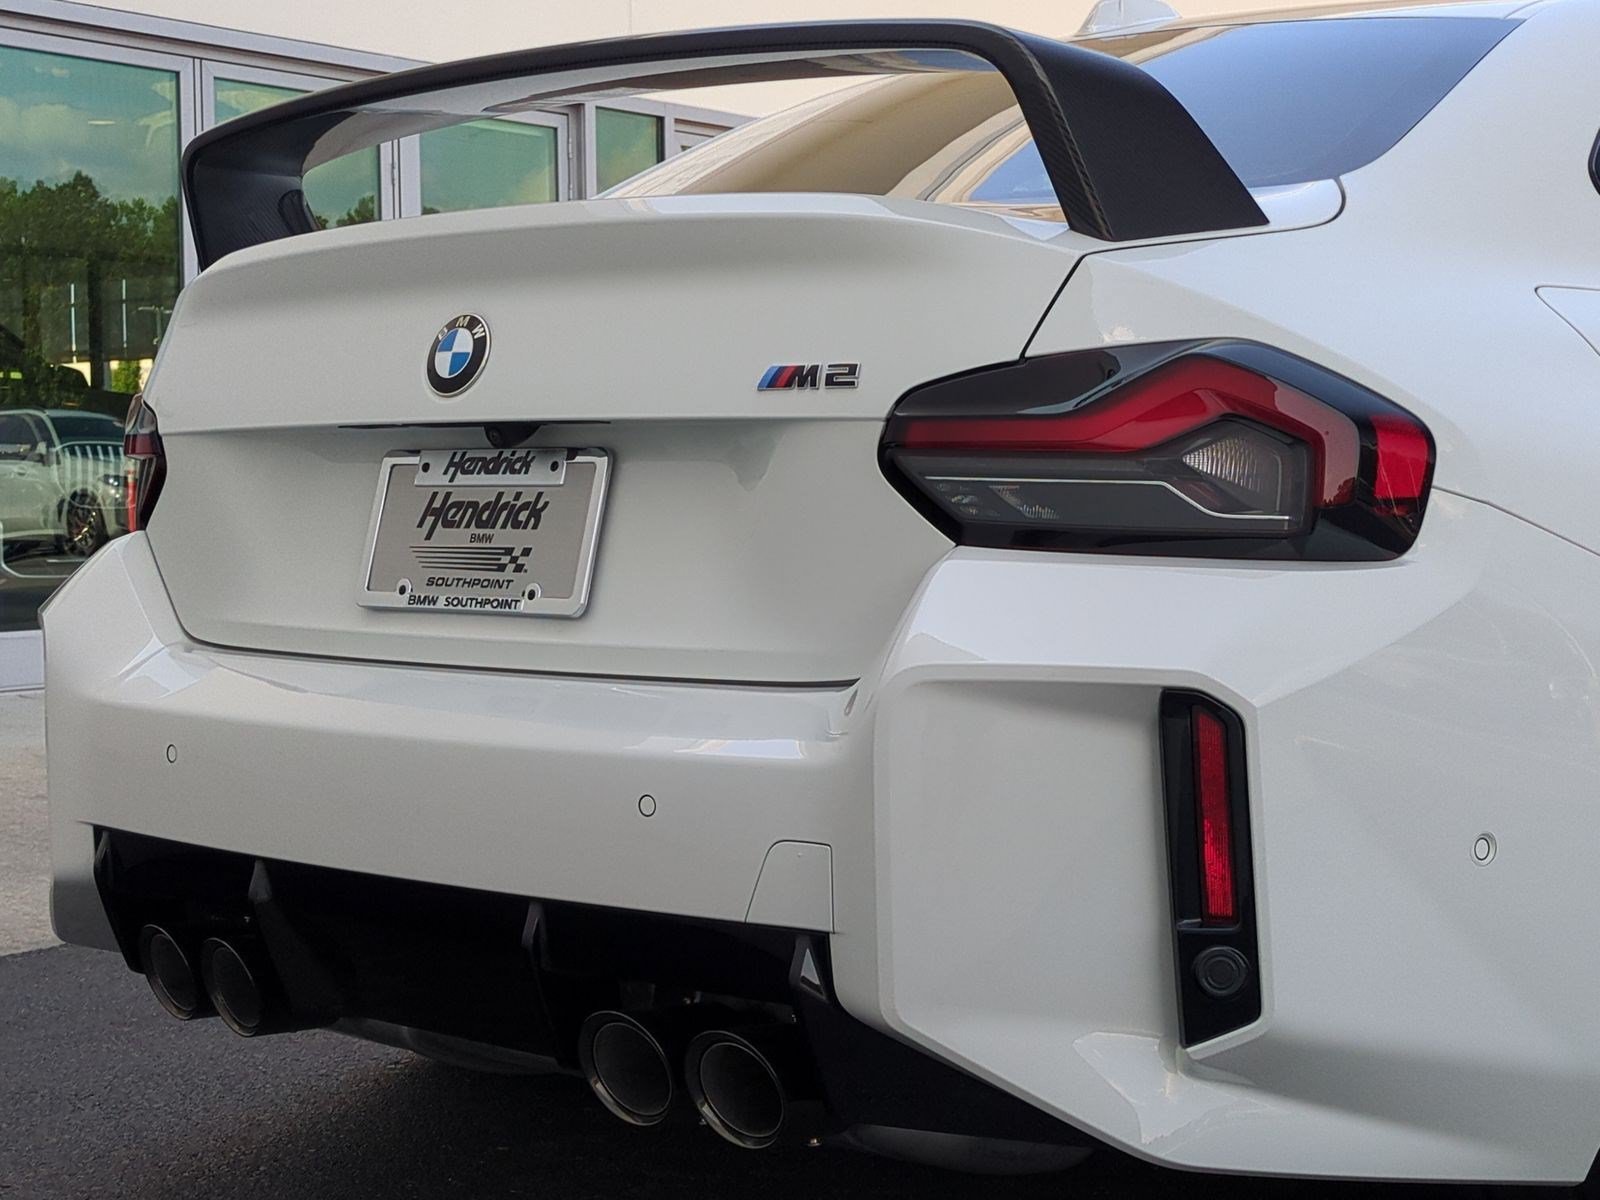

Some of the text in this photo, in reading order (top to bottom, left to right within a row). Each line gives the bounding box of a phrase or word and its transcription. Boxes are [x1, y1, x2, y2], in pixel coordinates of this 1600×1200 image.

[442, 450, 536, 483] Hendrick
[416, 491, 550, 541] Hendrick
[469, 533, 495, 544] BMW
[425, 576, 514, 590] SOUTHPOINT
[407, 594, 521, 611] BMW SOUTHPOINT
